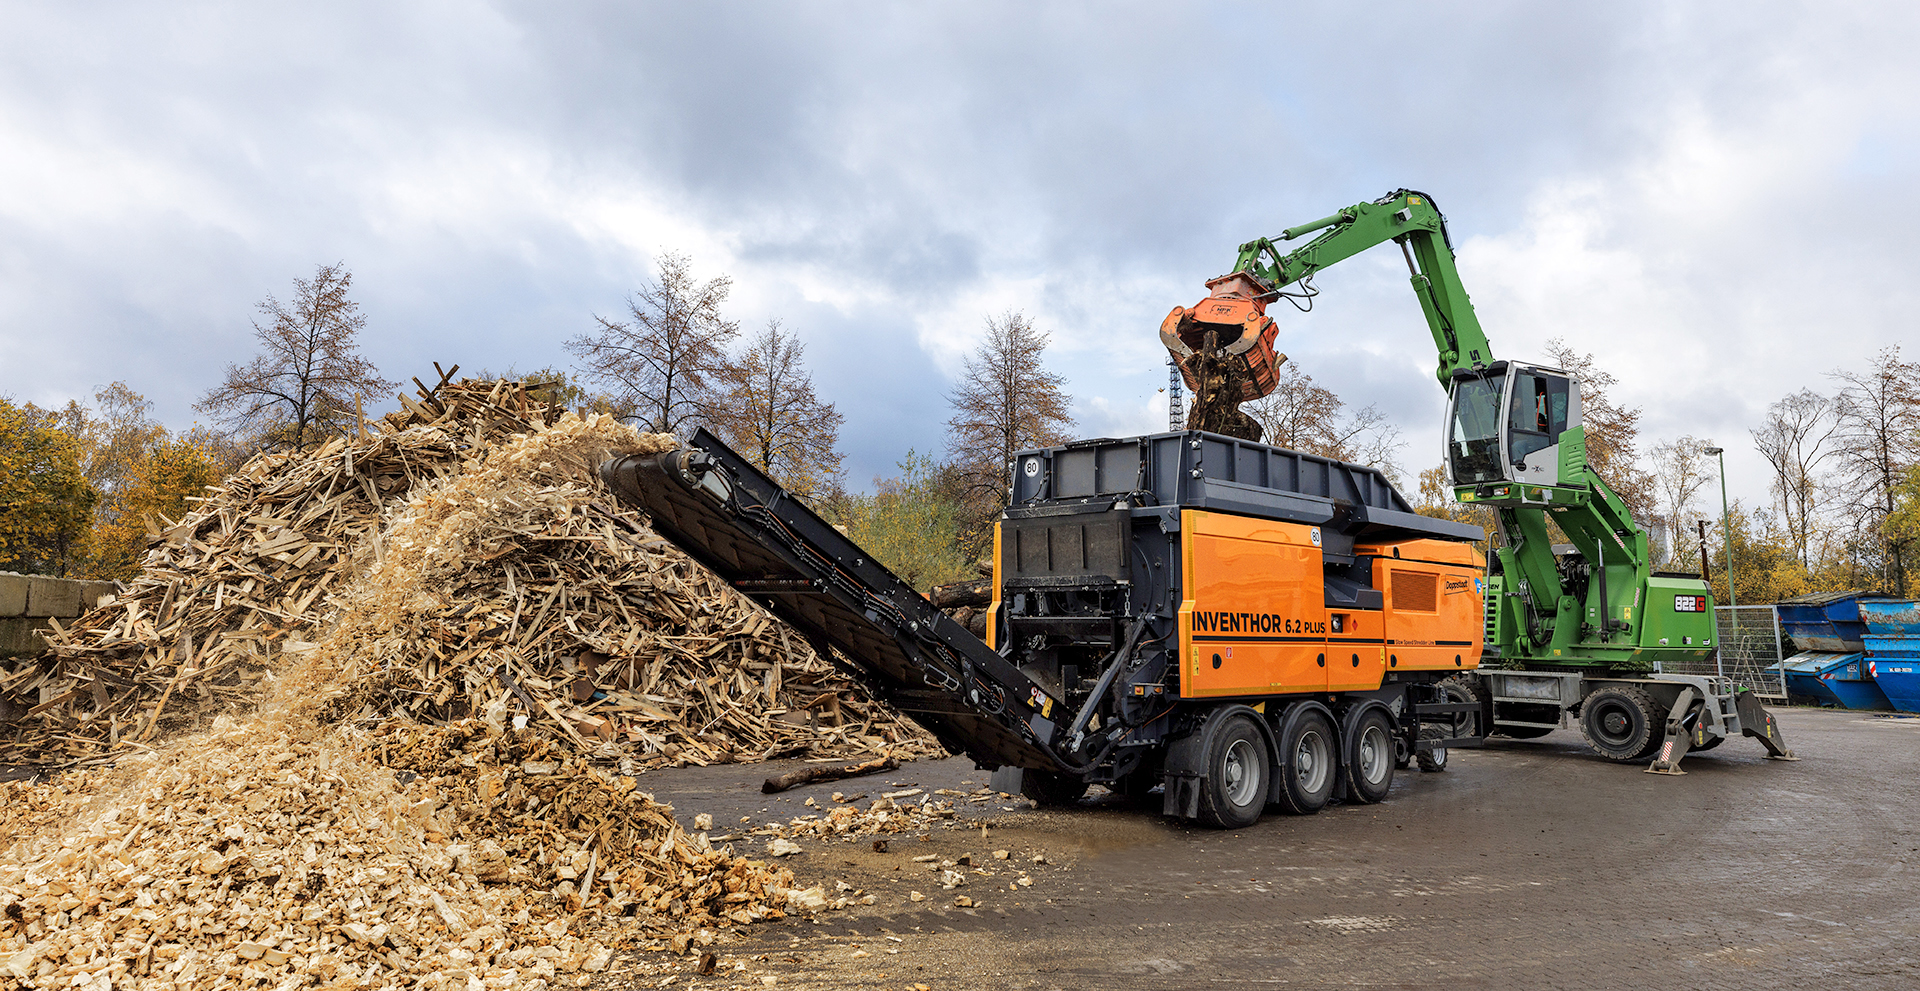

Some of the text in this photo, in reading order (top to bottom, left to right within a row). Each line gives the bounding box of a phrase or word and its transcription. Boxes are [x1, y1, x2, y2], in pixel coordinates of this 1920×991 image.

[1026, 462, 1037, 473] 80
[1311, 531, 1320, 542] 80
[1446, 580, 1468, 590] Doppstadt
[1675, 595, 1706, 612] 822G
[1192, 611, 1326, 634] INVENTHOR 6.2 PLUS
